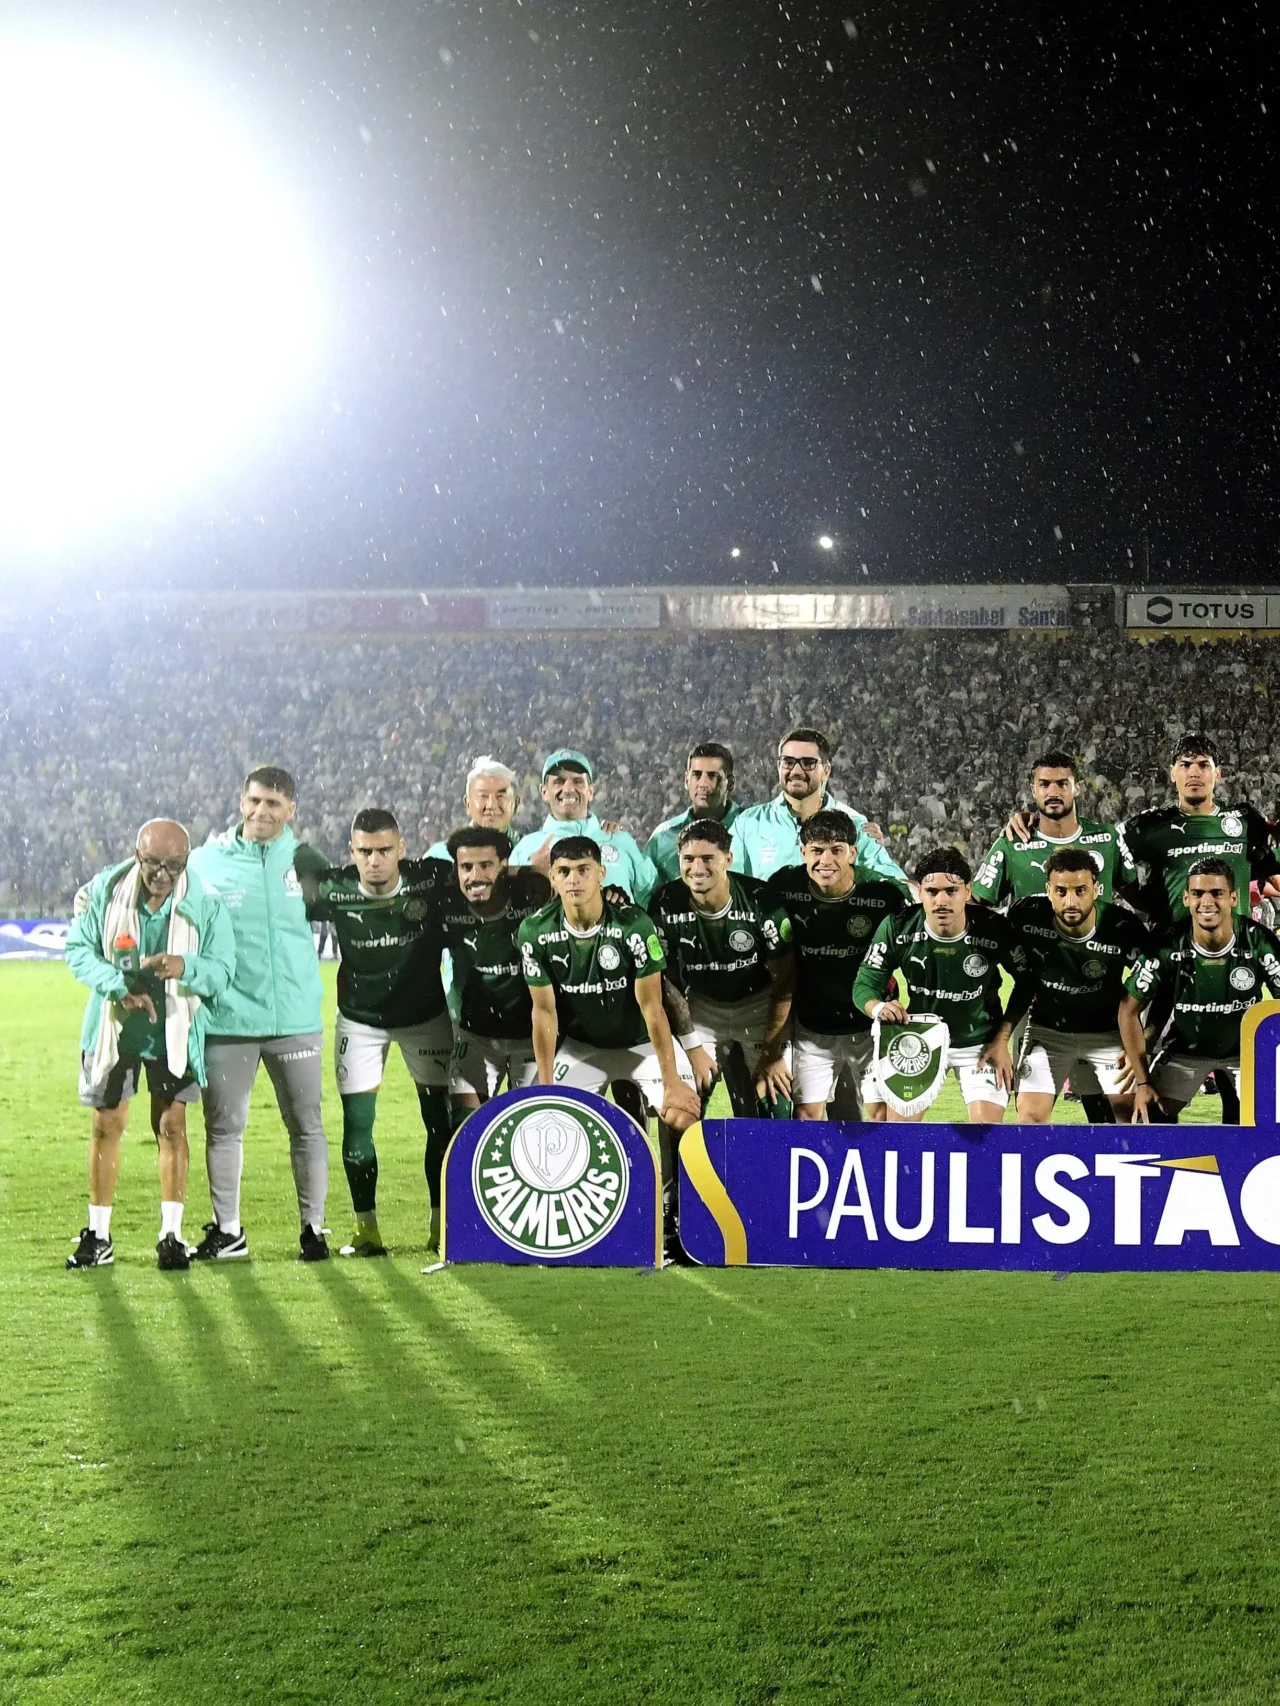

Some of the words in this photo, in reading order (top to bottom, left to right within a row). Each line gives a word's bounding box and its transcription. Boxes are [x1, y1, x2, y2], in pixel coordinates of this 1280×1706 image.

[1178, 602, 1255, 619] TOTUS
[1013, 840, 1048, 852] CIMED
[1079, 832, 1112, 845] CIMED
[1167, 842, 1243, 859] sportingbet
[400, 878, 436, 896] CIMED
[848, 896, 887, 909] CIMED
[444, 914, 476, 925] CIMED
[667, 912, 697, 925] CIMED
[538, 929, 569, 945] CIMED
[895, 931, 929, 945] CIMED
[1022, 923, 1059, 940] CIMED
[963, 934, 999, 950] CIMED
[1085, 939, 1122, 955] CIMED
[686, 951, 759, 973] portingbet
[909, 983, 984, 1002] sportingbet
[1175, 997, 1257, 1015] sportingbet
[339, 1036, 349, 1055] 8
[889, 1049, 930, 1074] PALMEIRAS
[553, 1061, 570, 1083] 19
[482, 1165, 620, 1247] PALMEIRAS
